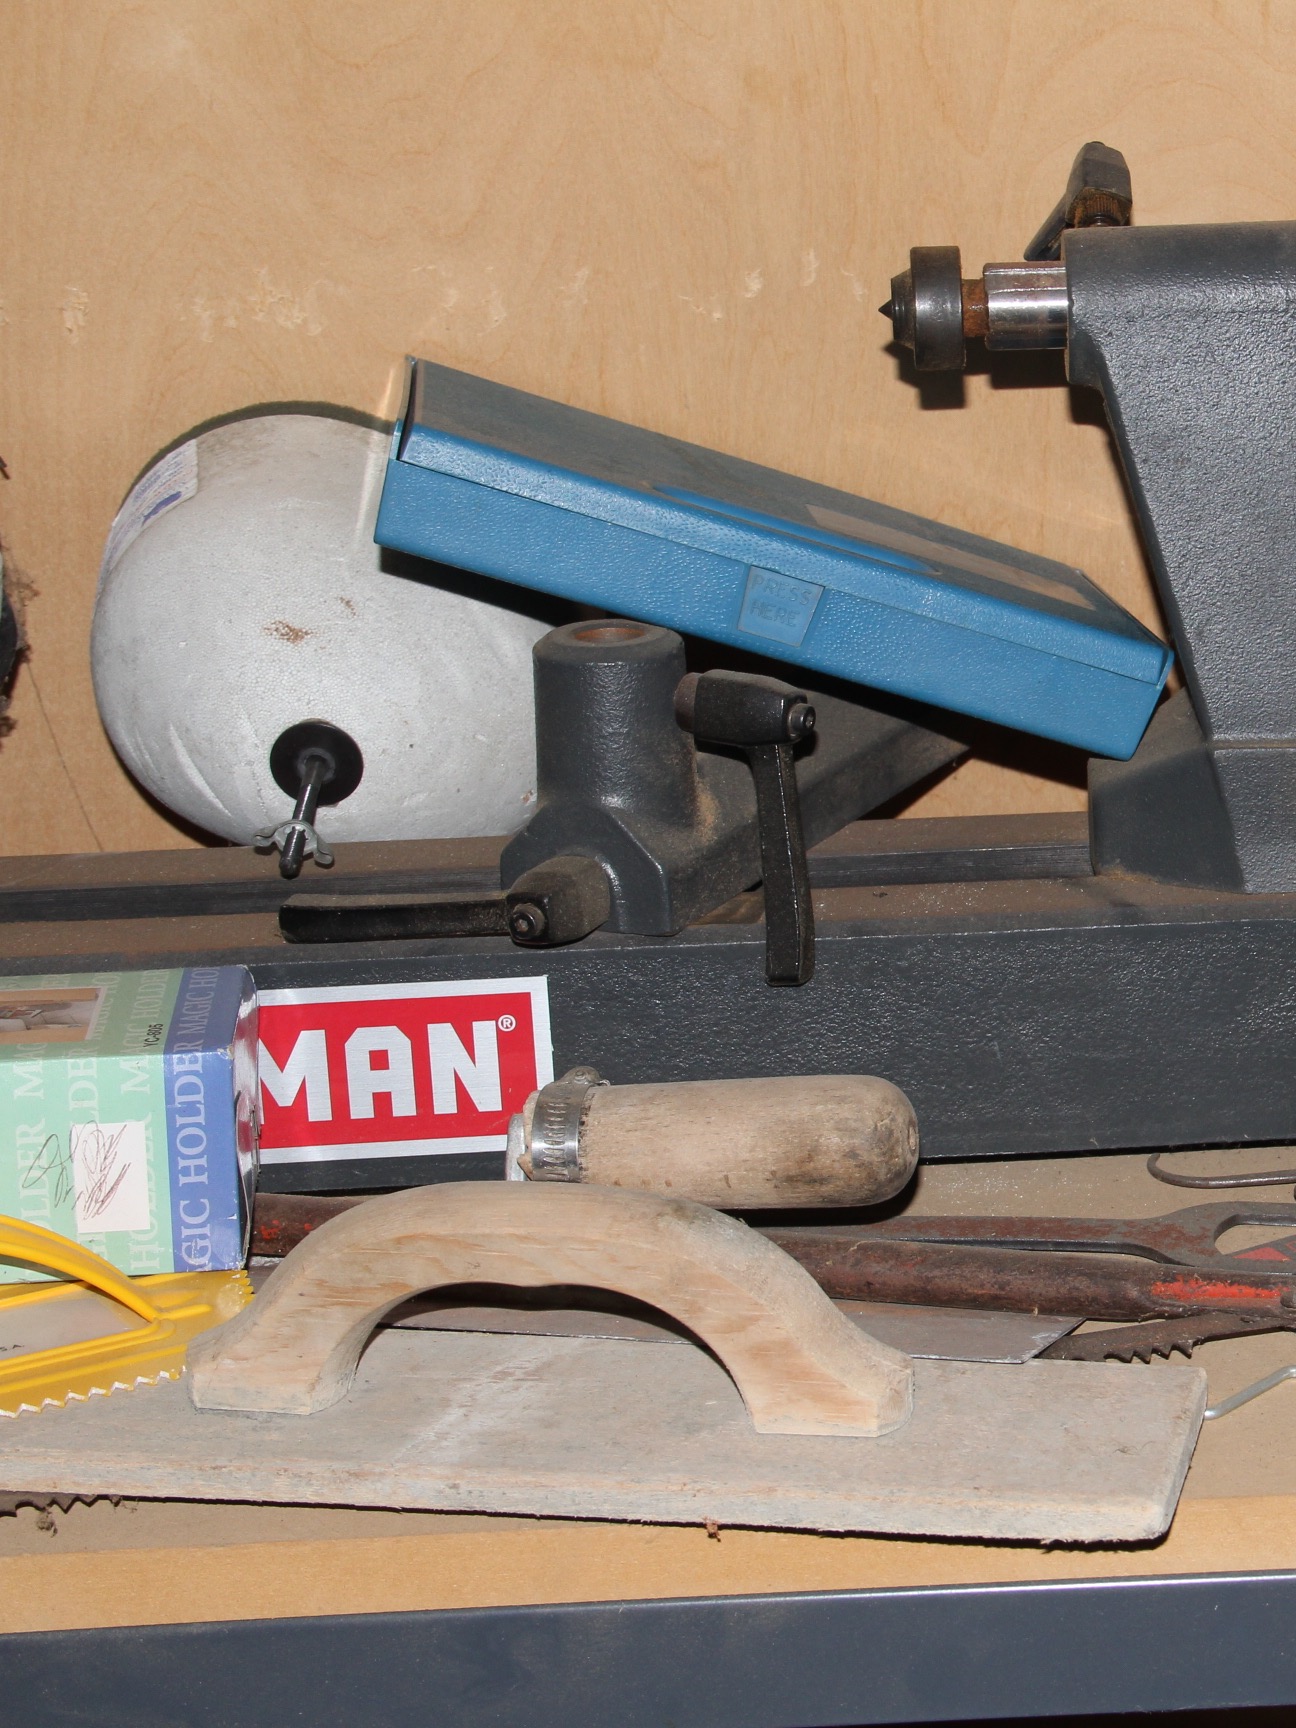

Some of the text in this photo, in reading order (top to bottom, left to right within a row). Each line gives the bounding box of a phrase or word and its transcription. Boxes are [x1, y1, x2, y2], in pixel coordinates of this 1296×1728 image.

[177, 991, 214, 1035] MAGIC
[143, 1023, 164, 1048] YC-805
[172, 1040, 208, 1187] HOLDER
